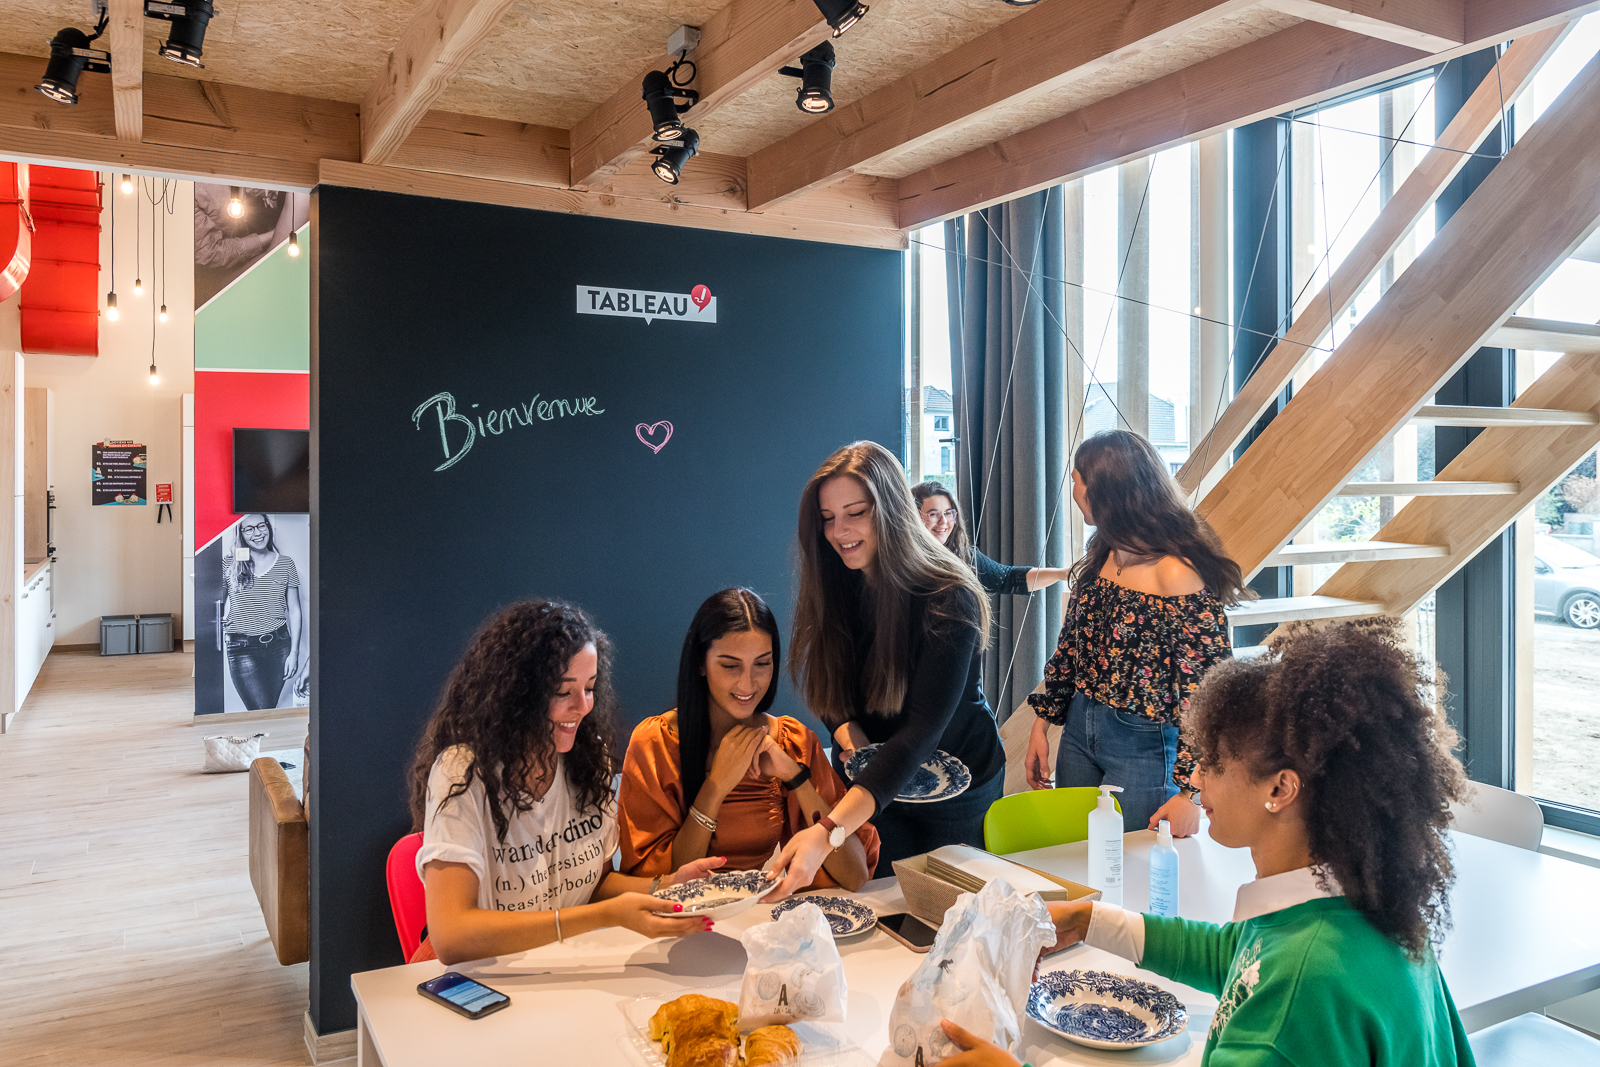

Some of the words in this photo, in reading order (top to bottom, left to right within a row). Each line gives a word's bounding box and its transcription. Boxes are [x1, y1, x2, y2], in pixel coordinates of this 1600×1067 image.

[587, 289, 688, 317] TABLEAU
[411, 391, 605, 472] Bienvenue
[495, 874, 526, 895] (n.)
